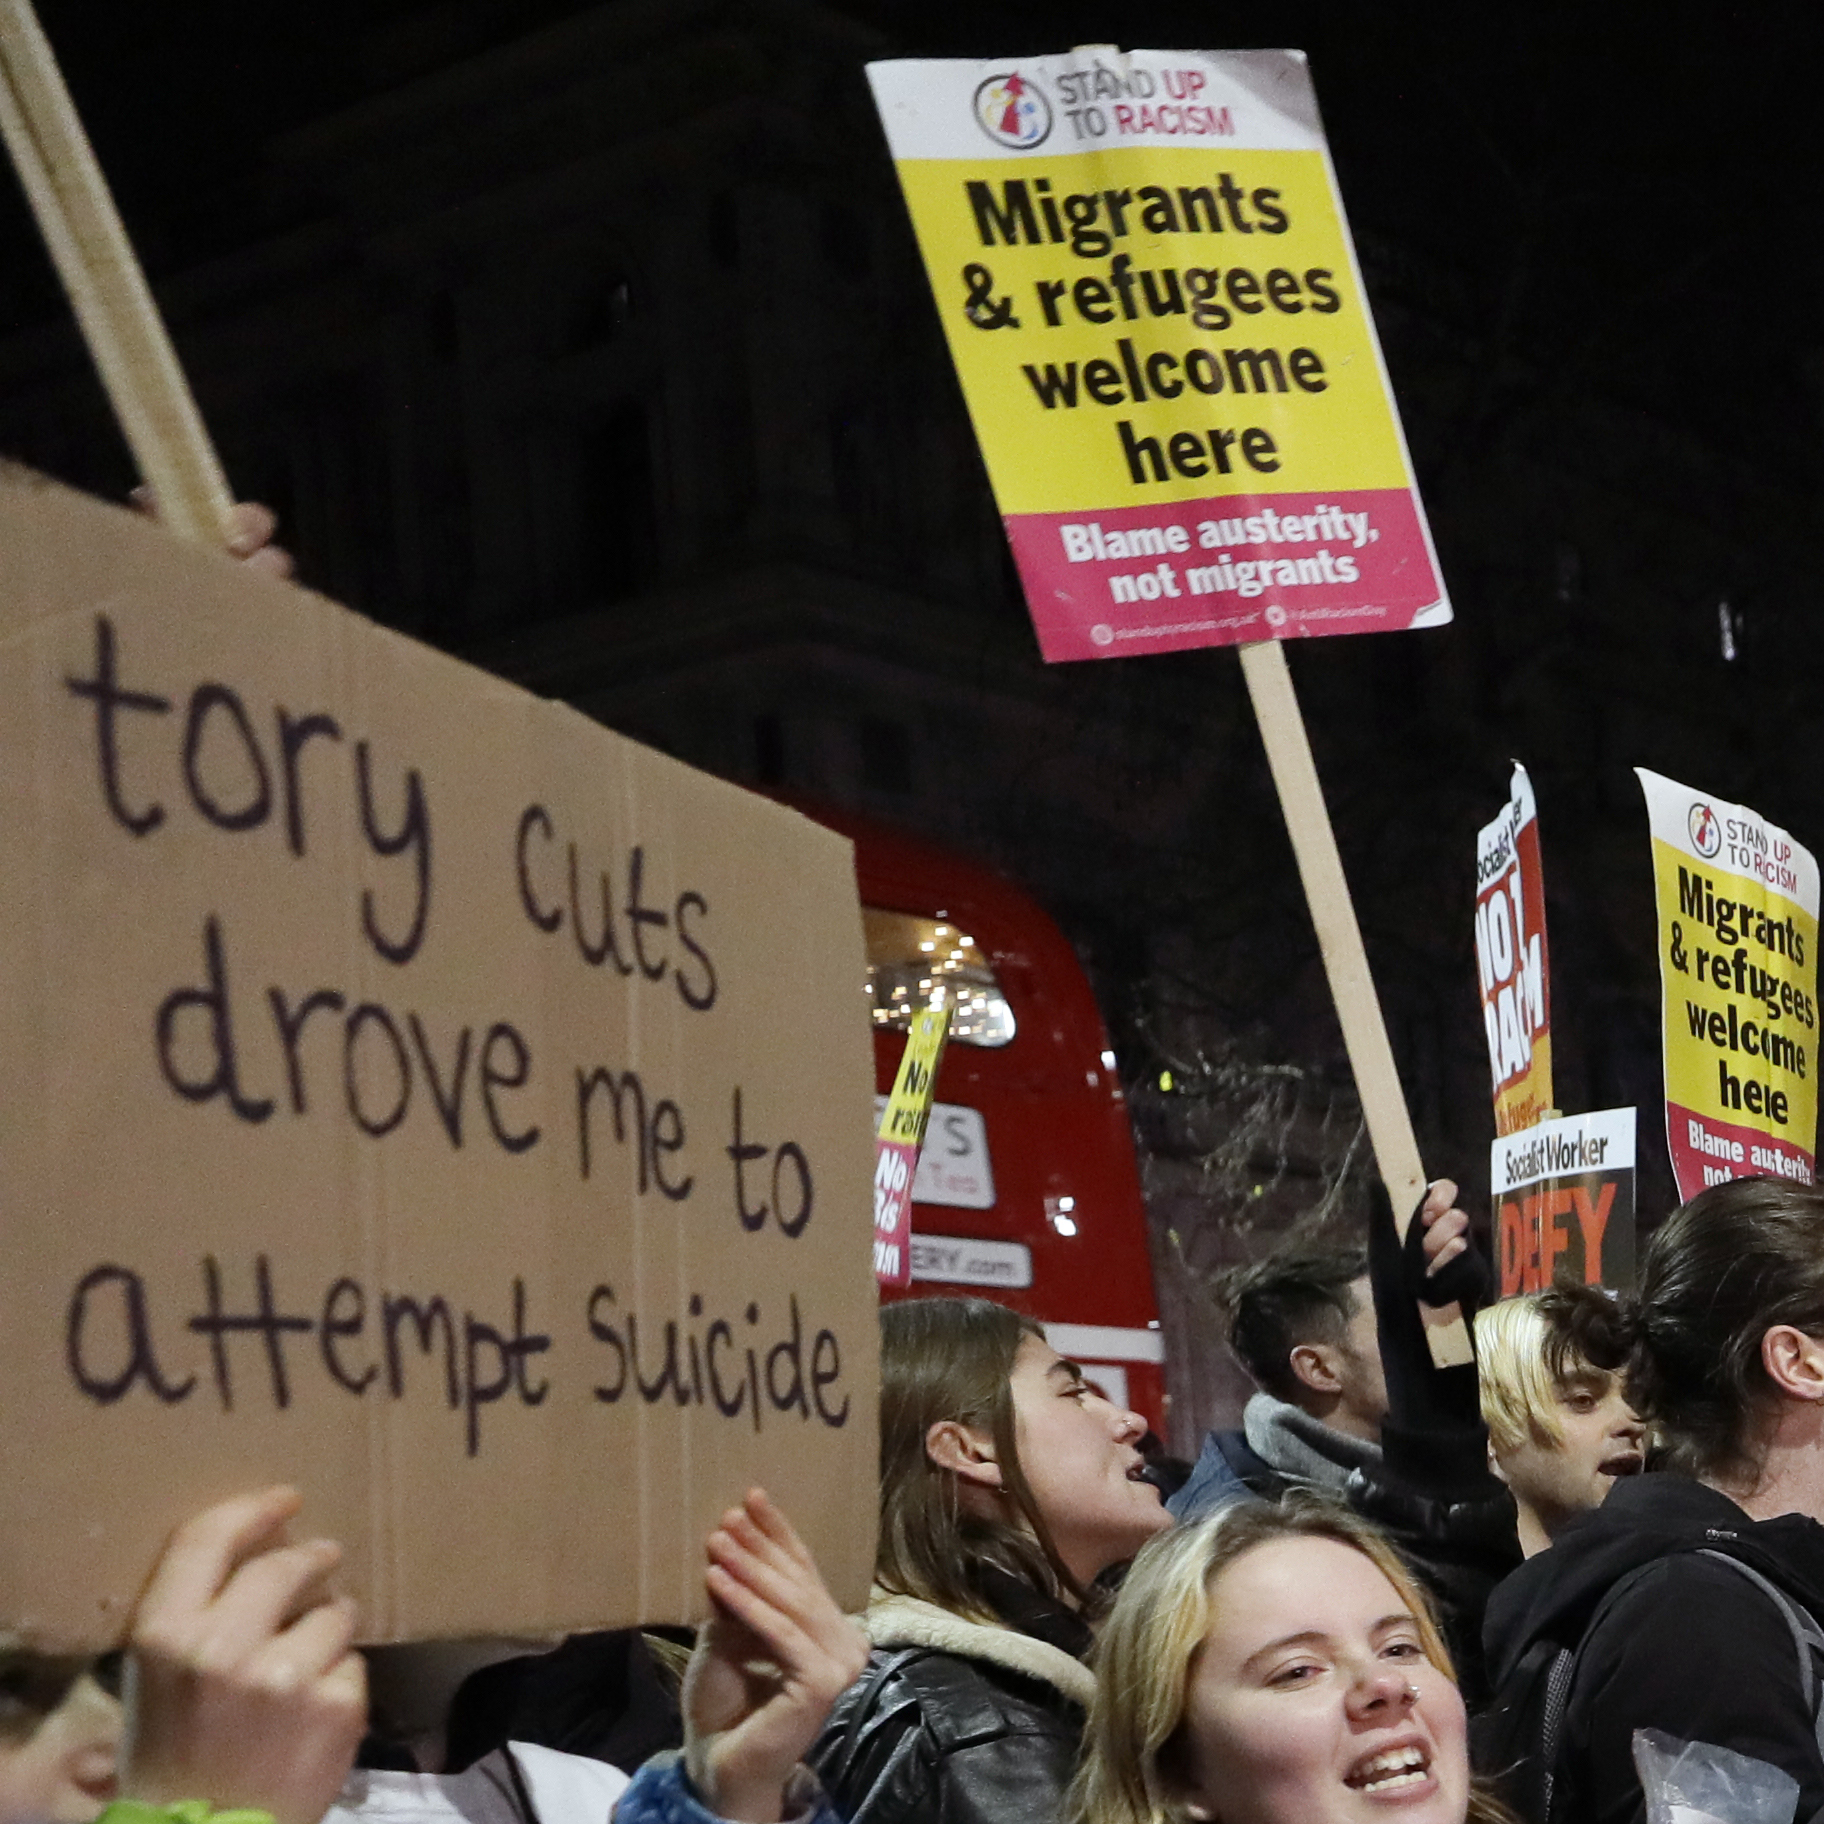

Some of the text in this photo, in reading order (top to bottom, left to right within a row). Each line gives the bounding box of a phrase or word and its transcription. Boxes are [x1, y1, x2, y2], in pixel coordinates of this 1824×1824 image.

[1055, 69, 1207, 105] STAND UP
[1066, 105, 1236, 139] TO RACISM
[964, 173, 1288, 258] Migrants
[963, 253, 1342, 331] & refugees
[1022, 339, 1328, 410] welcome
[1115, 421, 1281, 485] here
[1059, 504, 1379, 563] Blame austerity,
[1108, 549, 1359, 604] not migrants
[64, 613, 432, 966] tory
[1728, 843, 1750, 868] TO
[1774, 840, 1792, 864] UP
[517, 803, 719, 1012] cuts
[1678, 864, 1804, 968] Migrants
[1671, 921, 1813, 1030] & refugees
[1686, 1000, 1806, 1079] welcome
[154, 915, 815, 1240] drove me to
[1506, 1130, 1608, 1184] Socialist Worker
[1688, 1119, 1744, 1163] Blame
[1502, 1183, 1618, 1298] DEFY
[68, 1255, 850, 1459] attempt suicide
